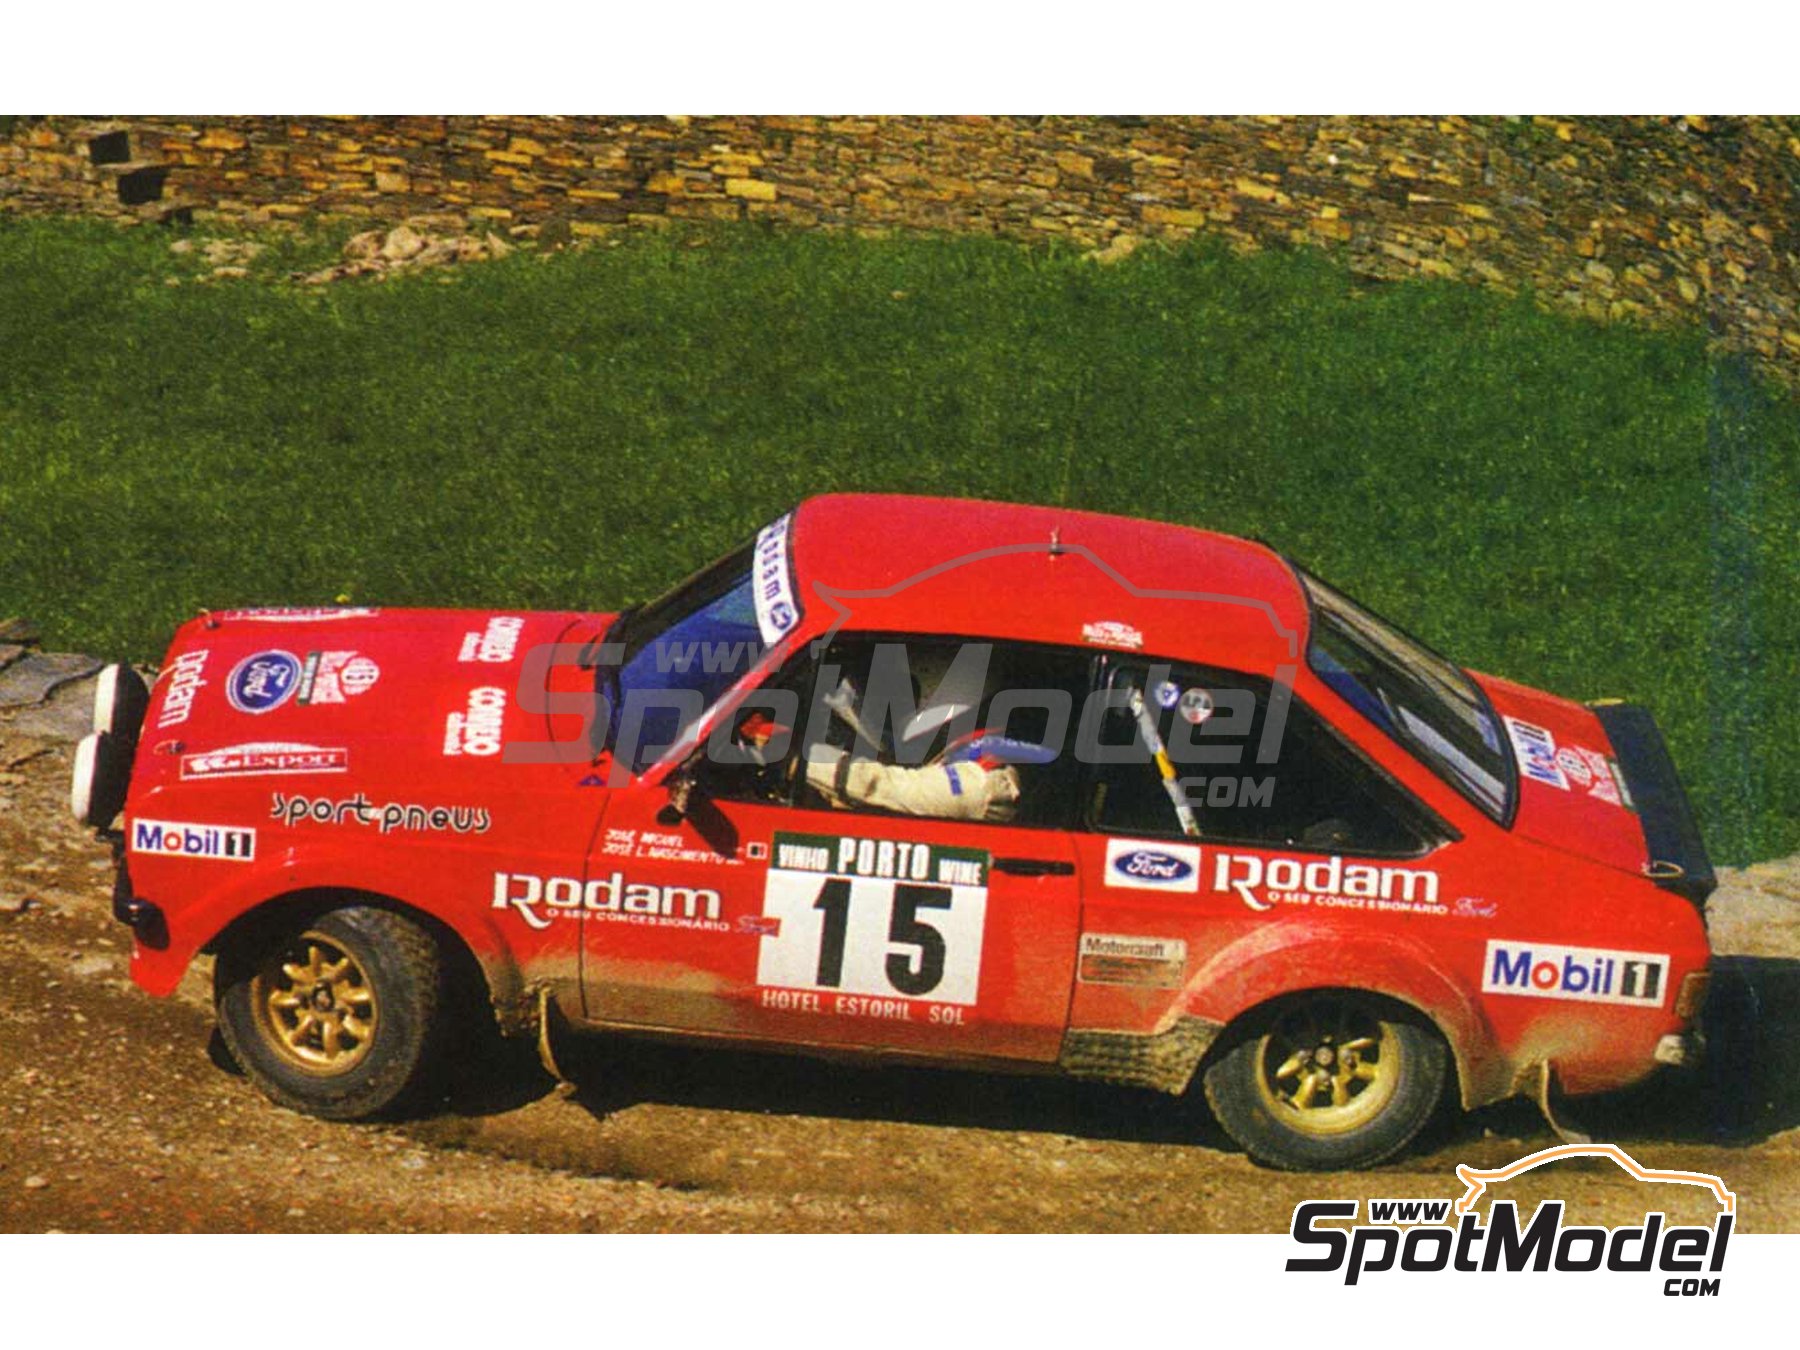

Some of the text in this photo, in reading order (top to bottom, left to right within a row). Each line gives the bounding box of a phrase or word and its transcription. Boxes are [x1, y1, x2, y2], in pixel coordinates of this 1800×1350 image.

[136, 823, 246, 857] Mobil 1
[778, 836, 983, 886] VINHO PORTO WINE
[1120, 849, 1184, 879] Ford
[1213, 853, 1440, 912] Rodam
[491, 871, 722, 929] Rodam
[546, 908, 560, 919] O
[563, 909, 592, 920] SEU
[1267, 891, 1281, 902] O
[813, 877, 953, 997] 15
[1492, 948, 1653, 998] Mobil 1
[762, 989, 966, 1026] HOTEL ESTORIL SOL
